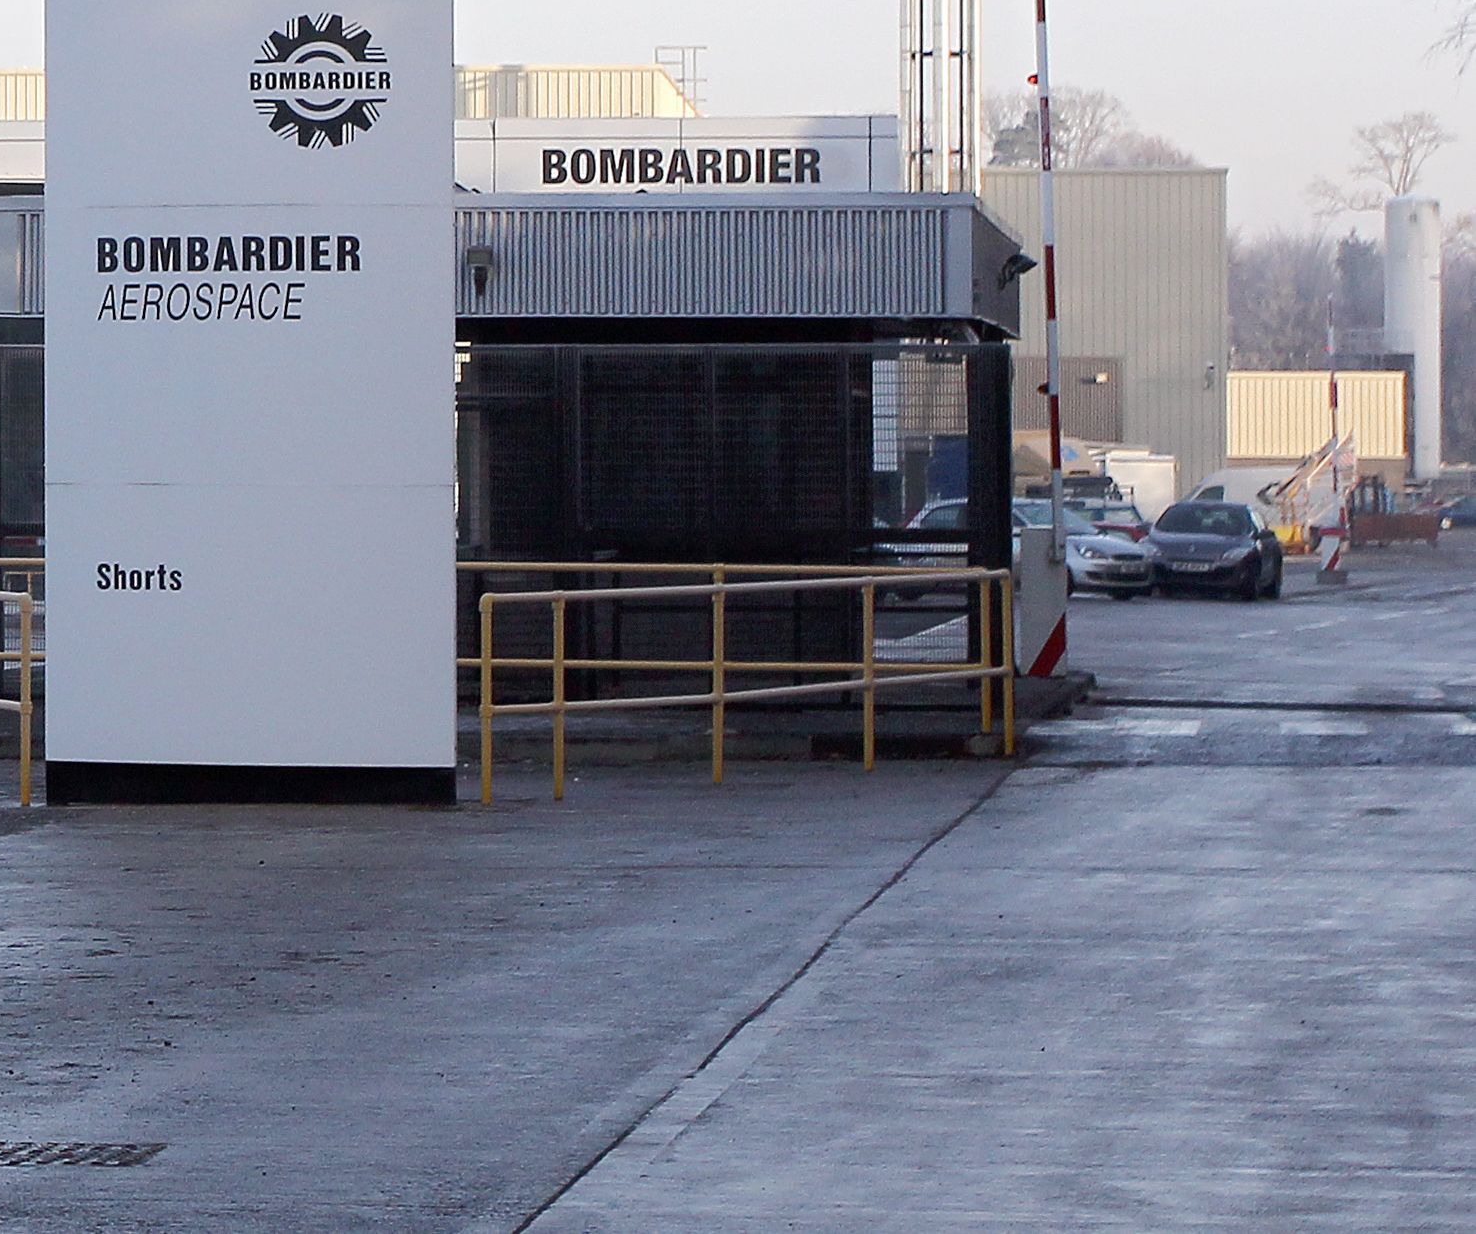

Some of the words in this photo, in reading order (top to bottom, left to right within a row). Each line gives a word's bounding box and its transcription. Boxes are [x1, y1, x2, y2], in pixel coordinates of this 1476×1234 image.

[249, 71, 392, 91] BOMBARDIER
[541, 147, 821, 185] BOMBARDIER
[96, 235, 361, 273] BOMBARDIER
[97, 281, 306, 321] AEROSPACE
[96, 563, 183, 591] Shorts
